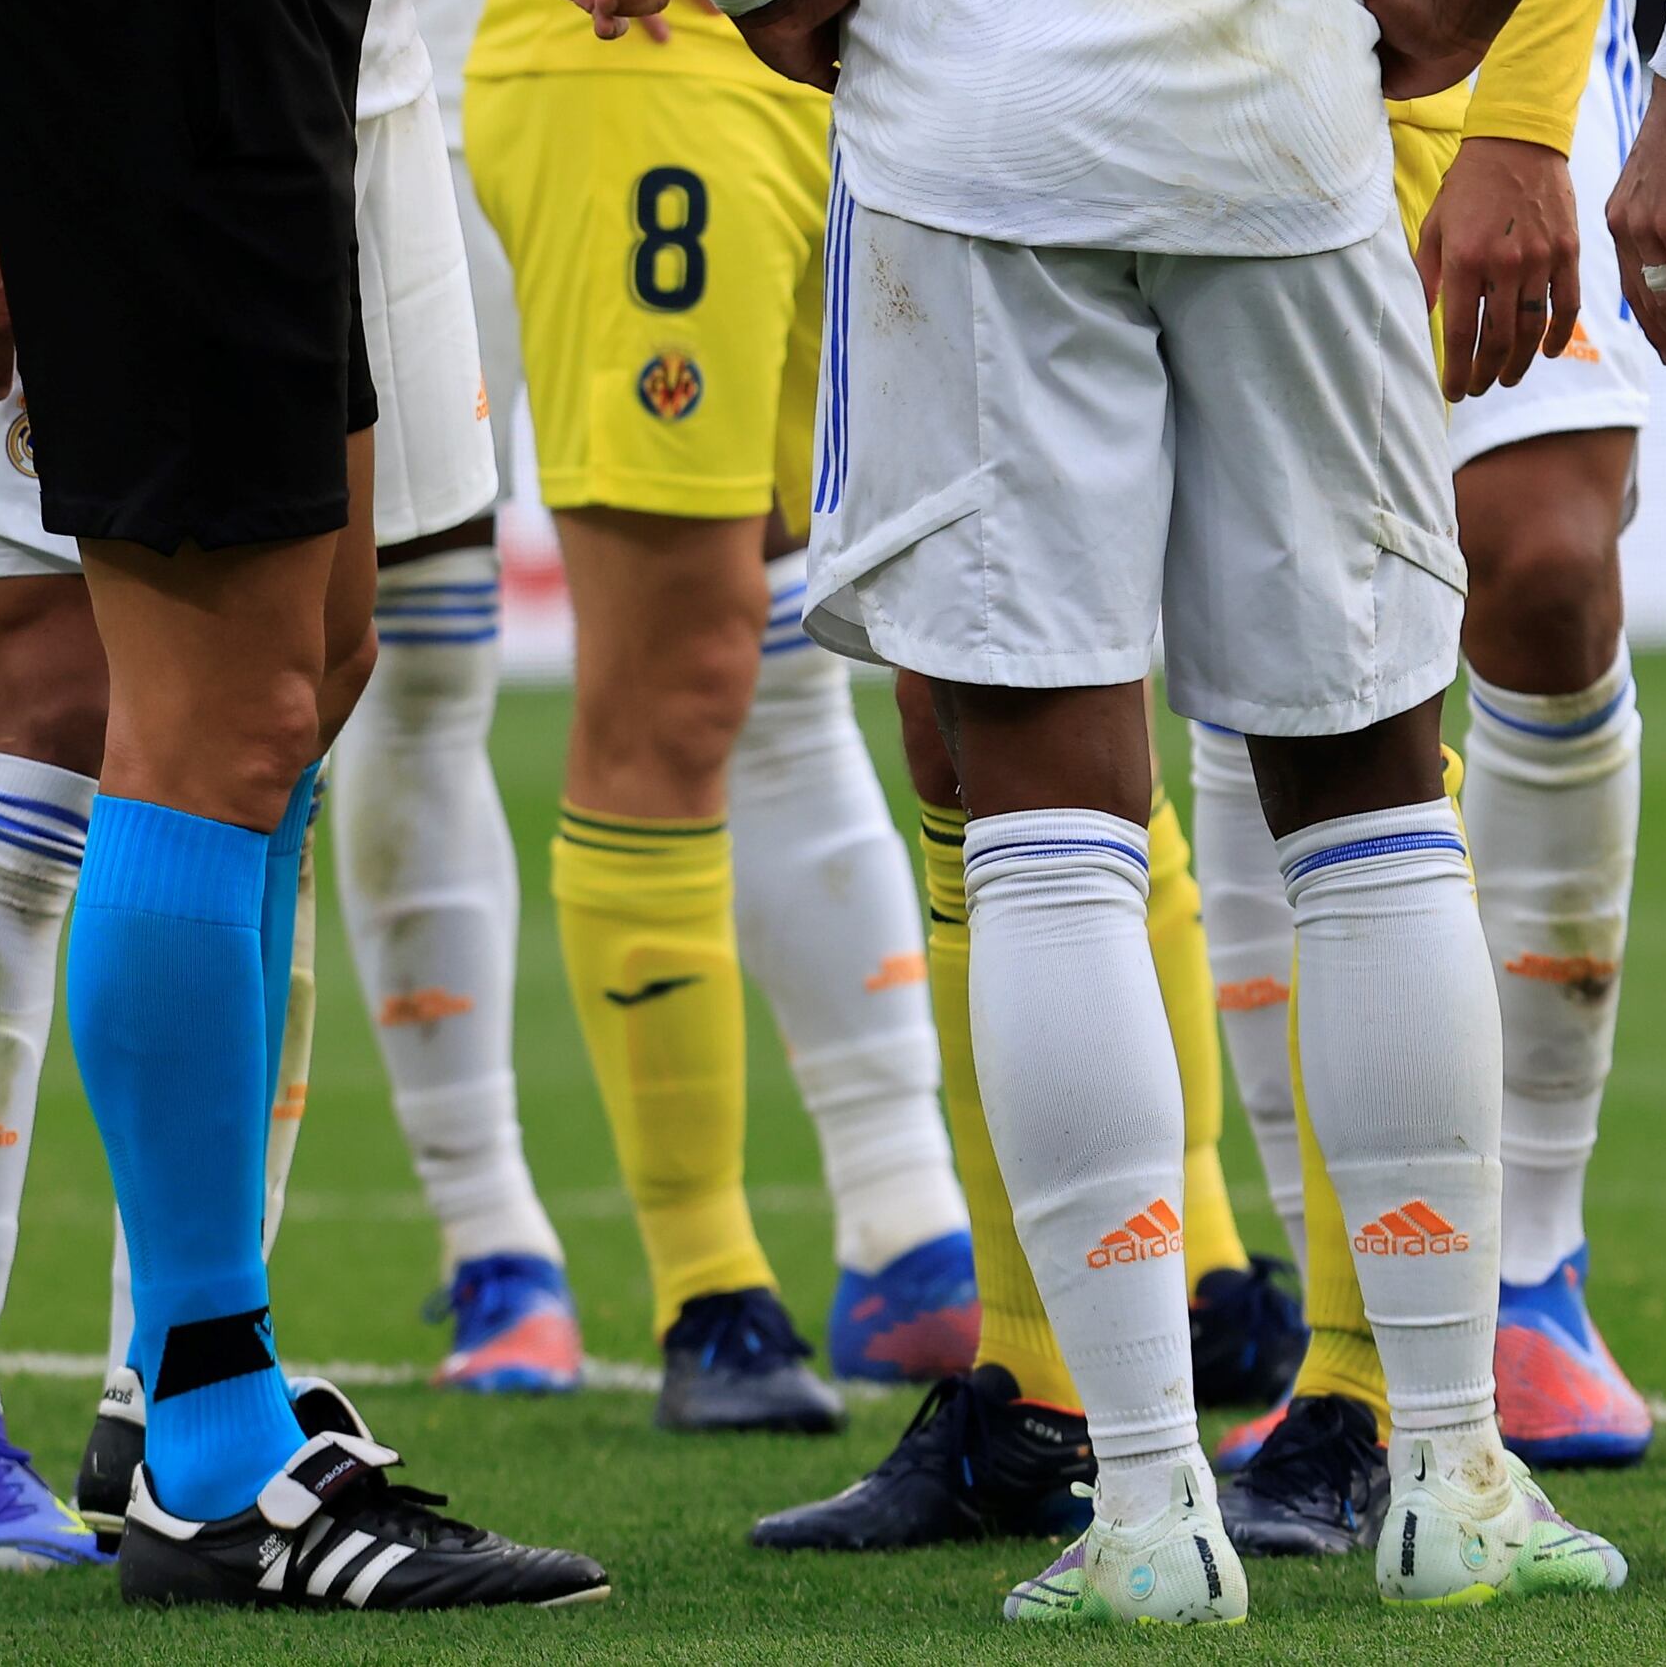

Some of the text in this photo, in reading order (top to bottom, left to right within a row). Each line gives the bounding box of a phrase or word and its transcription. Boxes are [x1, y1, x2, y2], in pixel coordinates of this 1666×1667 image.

[627, 165, 708, 313] 8
[1353, 1232, 1469, 1256] adidas
[1023, 1417, 1063, 1444] COPA
